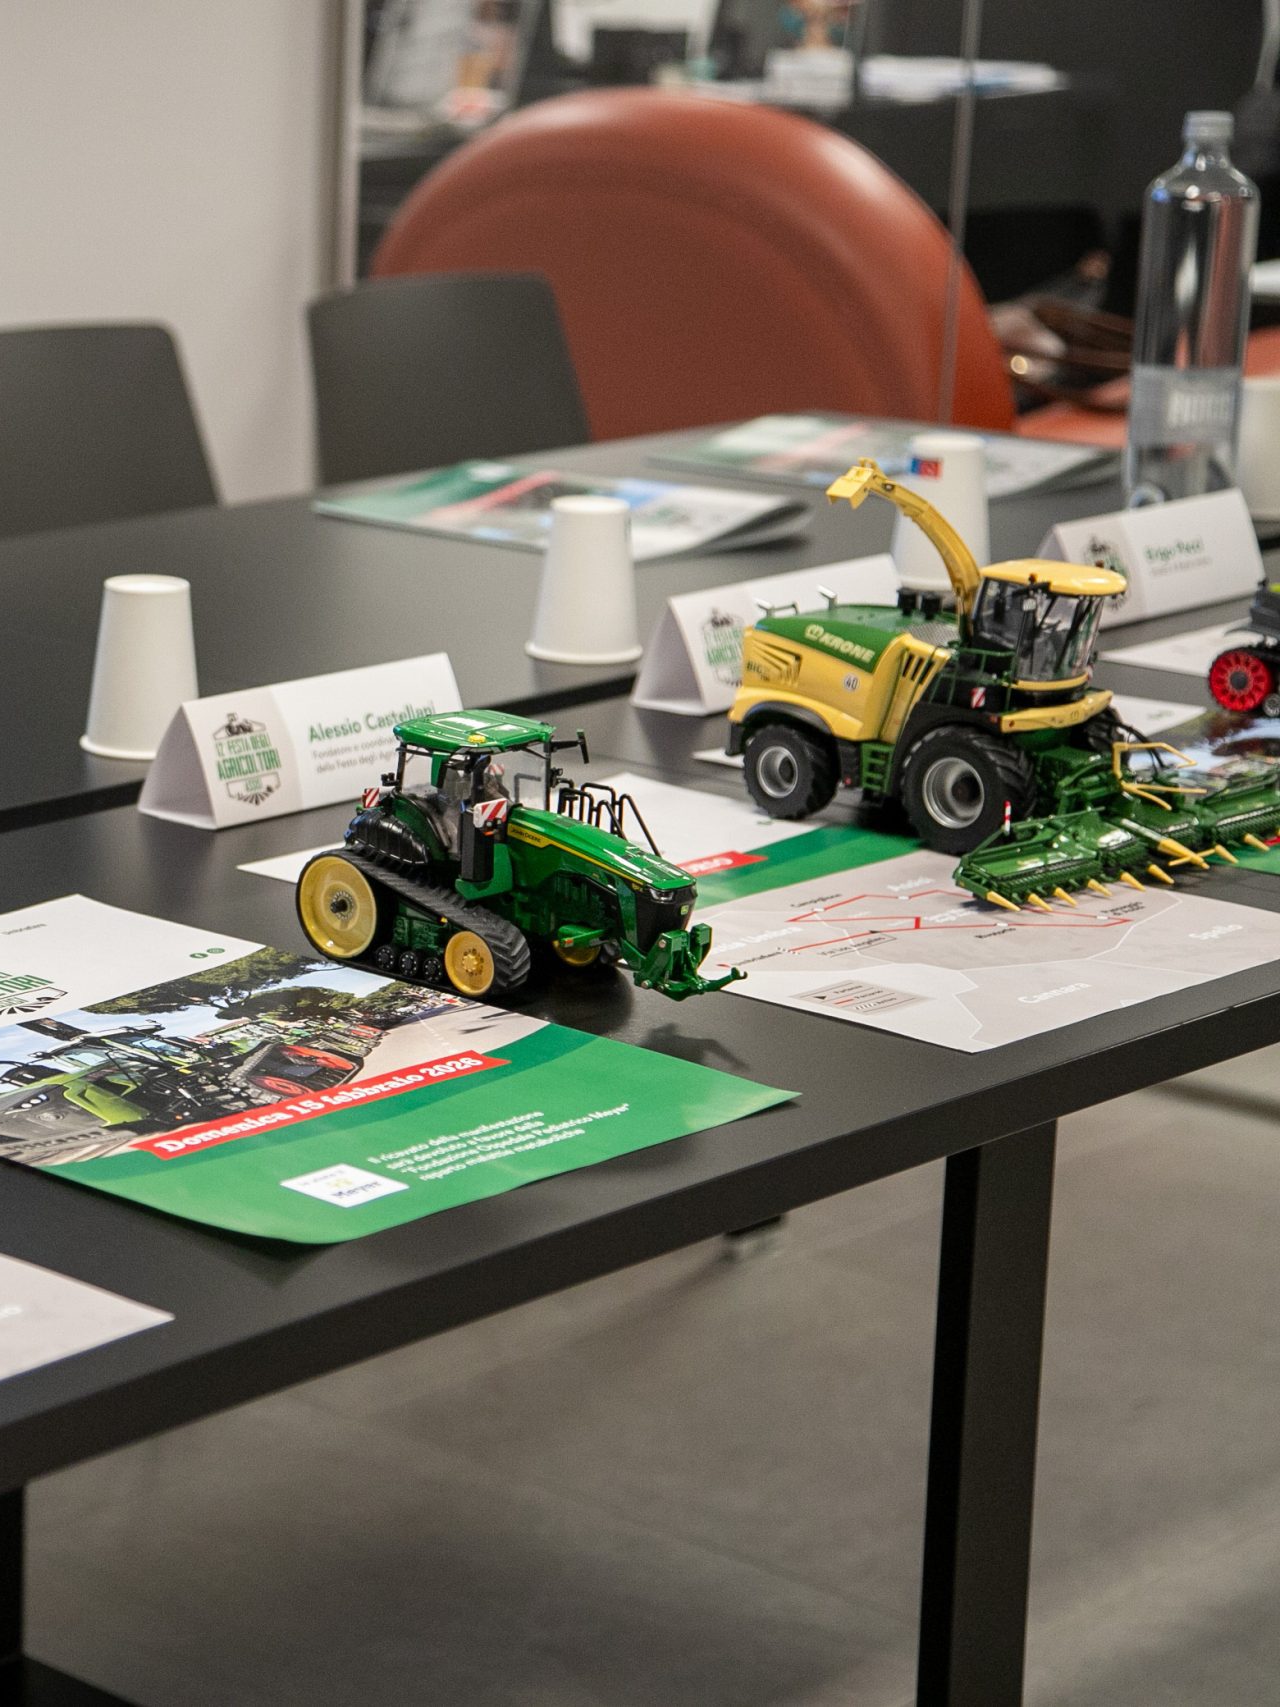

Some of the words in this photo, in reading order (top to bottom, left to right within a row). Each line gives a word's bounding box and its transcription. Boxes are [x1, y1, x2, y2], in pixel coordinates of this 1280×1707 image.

[818, 631, 876, 663] KRONE
[308, 717, 362, 743] Alessio
[217, 748, 281, 781] AGRICOLTORI
[153, 1112, 293, 1152] Domenica
[286, 1099, 326, 1116] 15
[320, 1074, 425, 1106] febbraio
[420, 1057, 484, 1078] 2026
